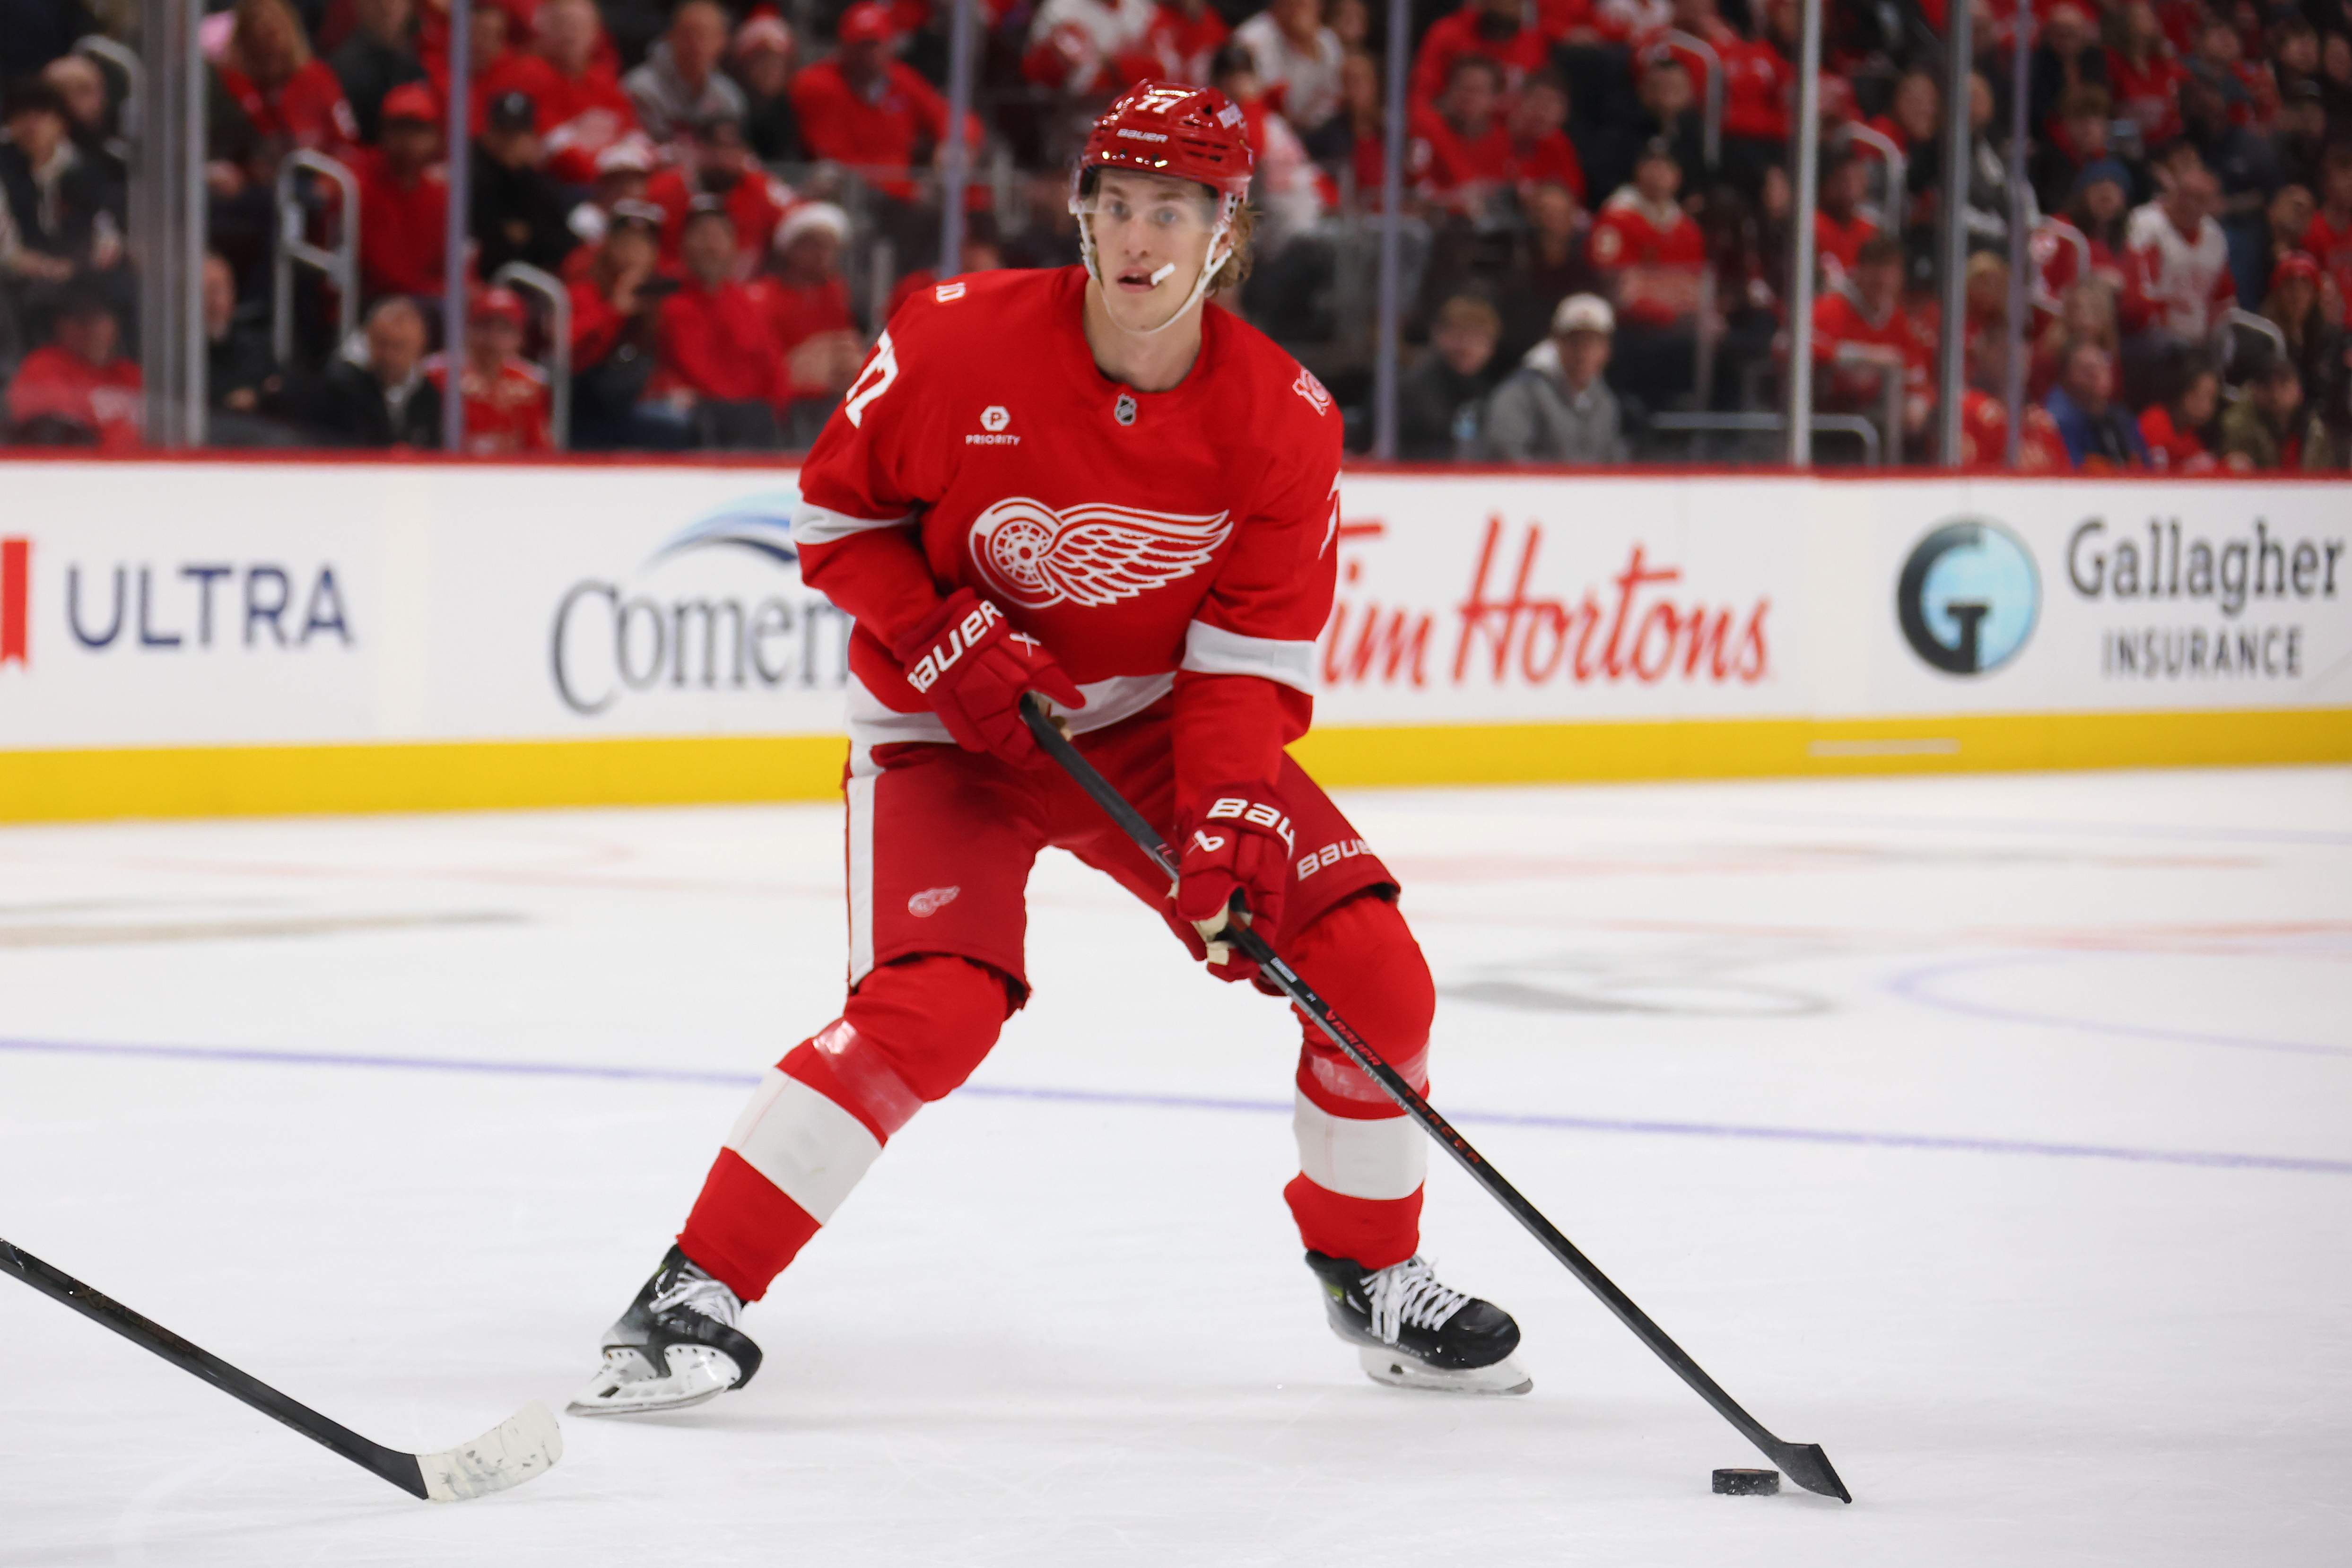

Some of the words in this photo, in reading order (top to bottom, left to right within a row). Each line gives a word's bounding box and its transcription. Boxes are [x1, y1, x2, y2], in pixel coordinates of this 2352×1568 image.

[1134, 94, 1184, 114] 77
[1116, 128, 1168, 144] BAUER
[965, 434, 1021, 446] PRIORITY
[2065, 515, 2345, 617] Gallagher
[66, 564, 356, 651] ULTRA
[1453, 513, 1772, 688] Hortons
[2100, 626, 2304, 680] INSURANCE
